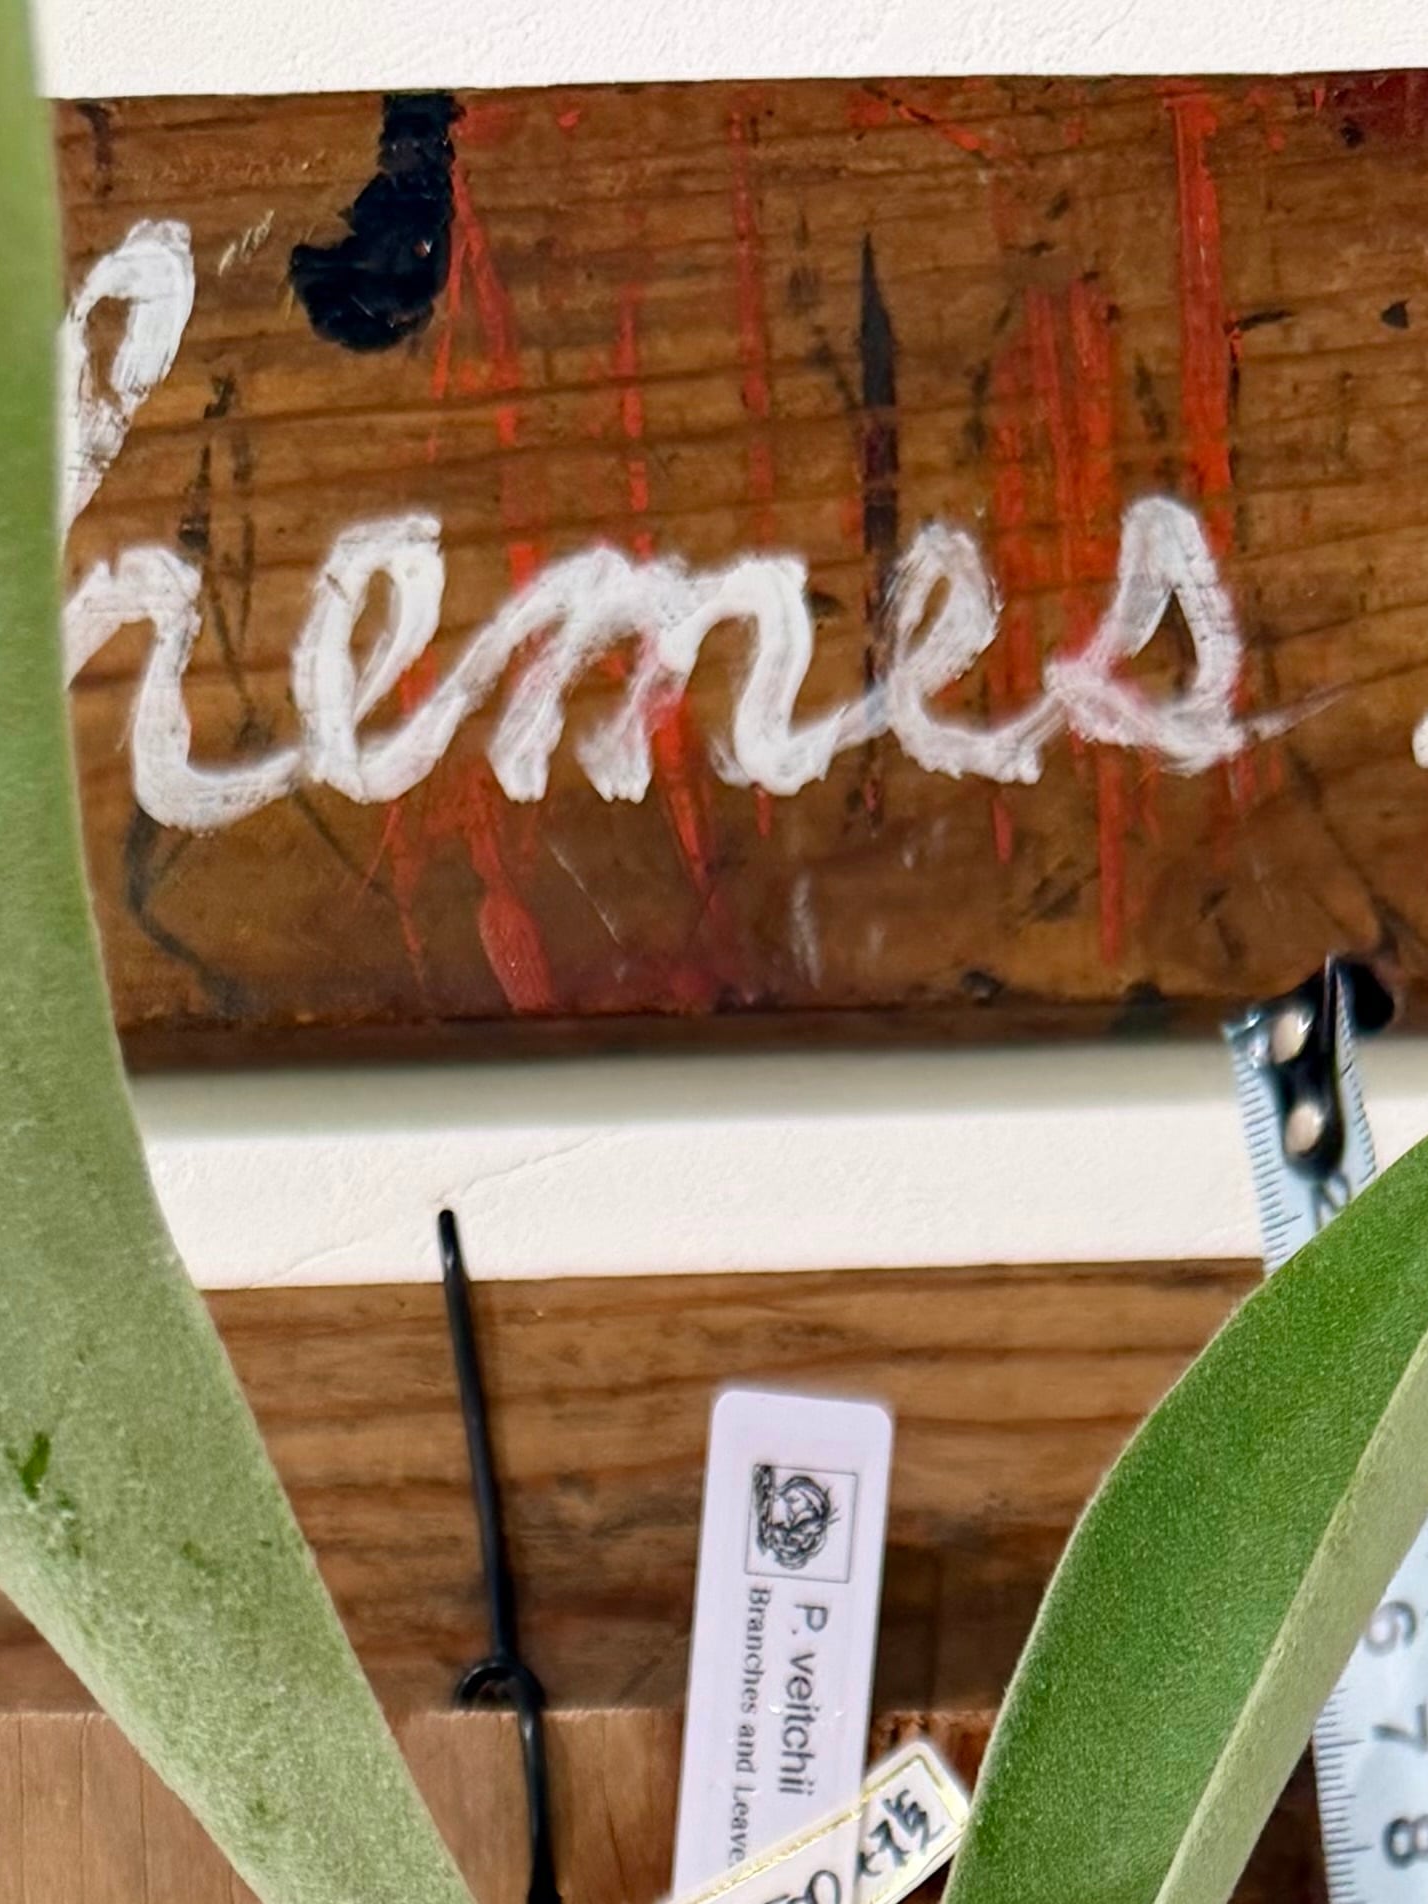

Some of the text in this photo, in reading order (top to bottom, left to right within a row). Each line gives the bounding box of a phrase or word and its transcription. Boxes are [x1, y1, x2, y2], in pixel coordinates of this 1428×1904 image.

[730, 1586, 771, 1866] Branches and Leave
[778, 1653, 816, 1796] veitchii
